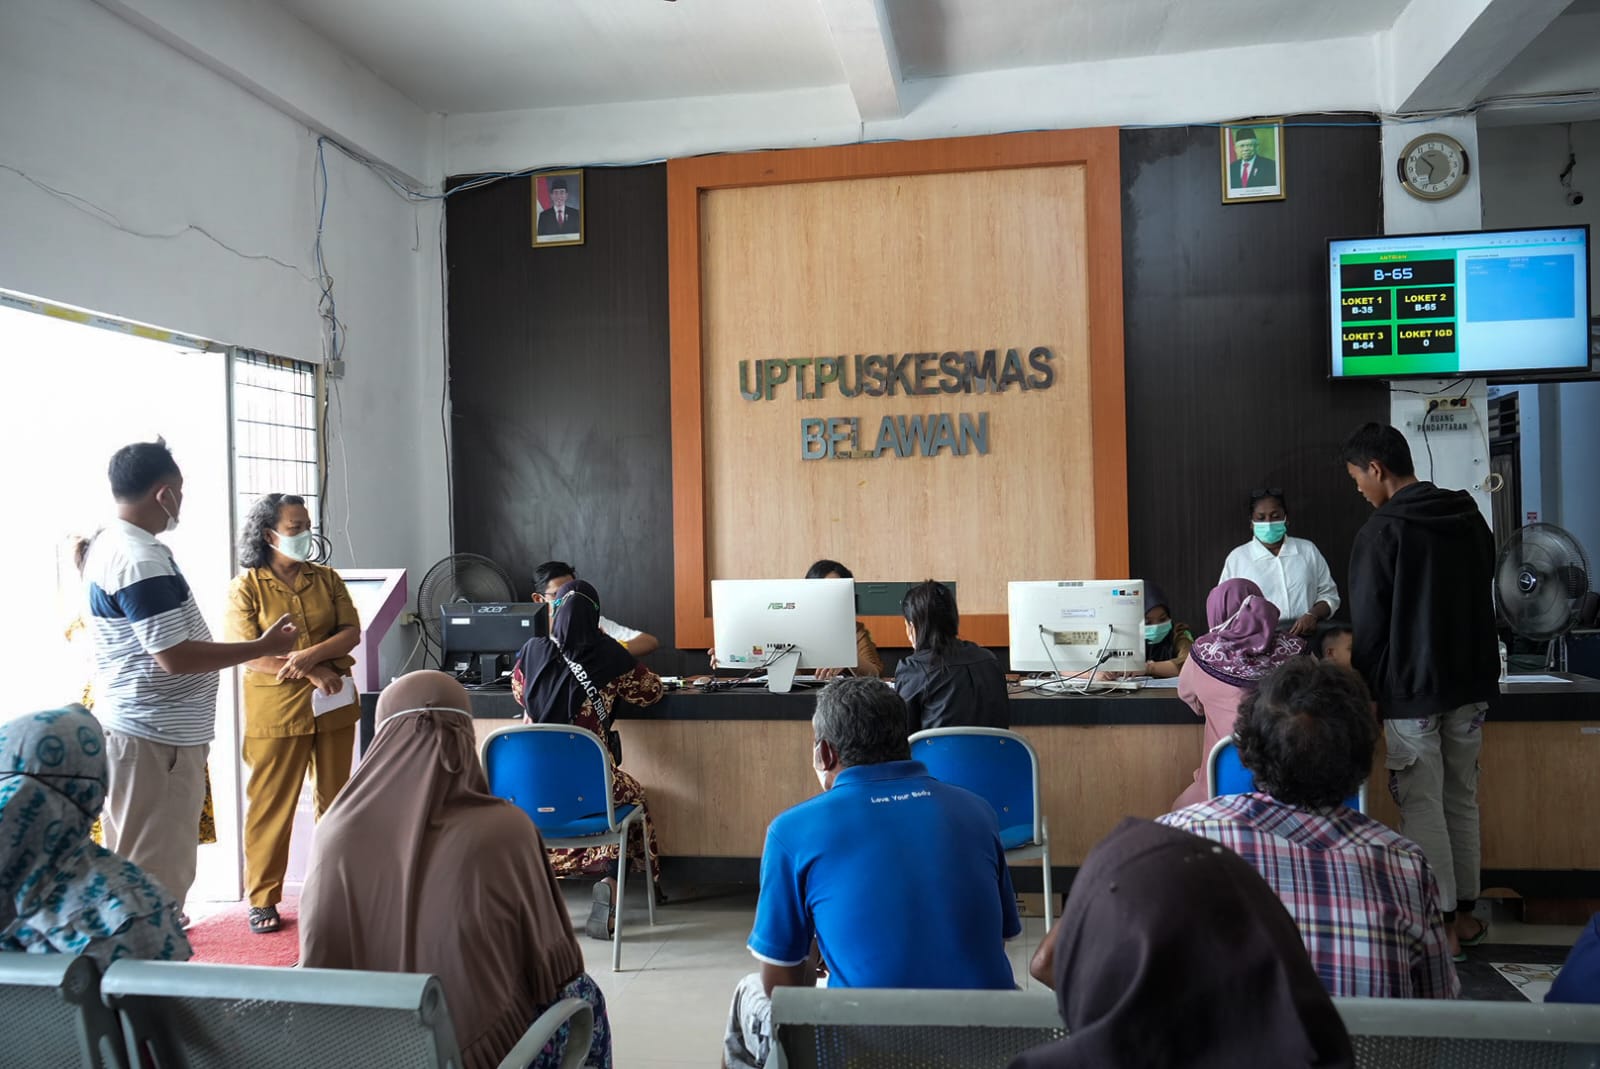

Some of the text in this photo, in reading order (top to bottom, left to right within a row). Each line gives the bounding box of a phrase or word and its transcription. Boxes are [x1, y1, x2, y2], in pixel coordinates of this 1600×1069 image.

[1374, 268, 1413, 281] B-65
[1342, 296, 1383, 306] LOKET 1
[1405, 293, 1447, 303] LOKET 2
[1352, 306, 1373, 314] B-35
[1343, 332, 1375, 341] LOKET
[1400, 329, 1453, 339] LOKET IGD
[801, 412, 988, 461] BELAWAN
[477, 605, 508, 614] acer
[768, 602, 796, 610] ASUS
